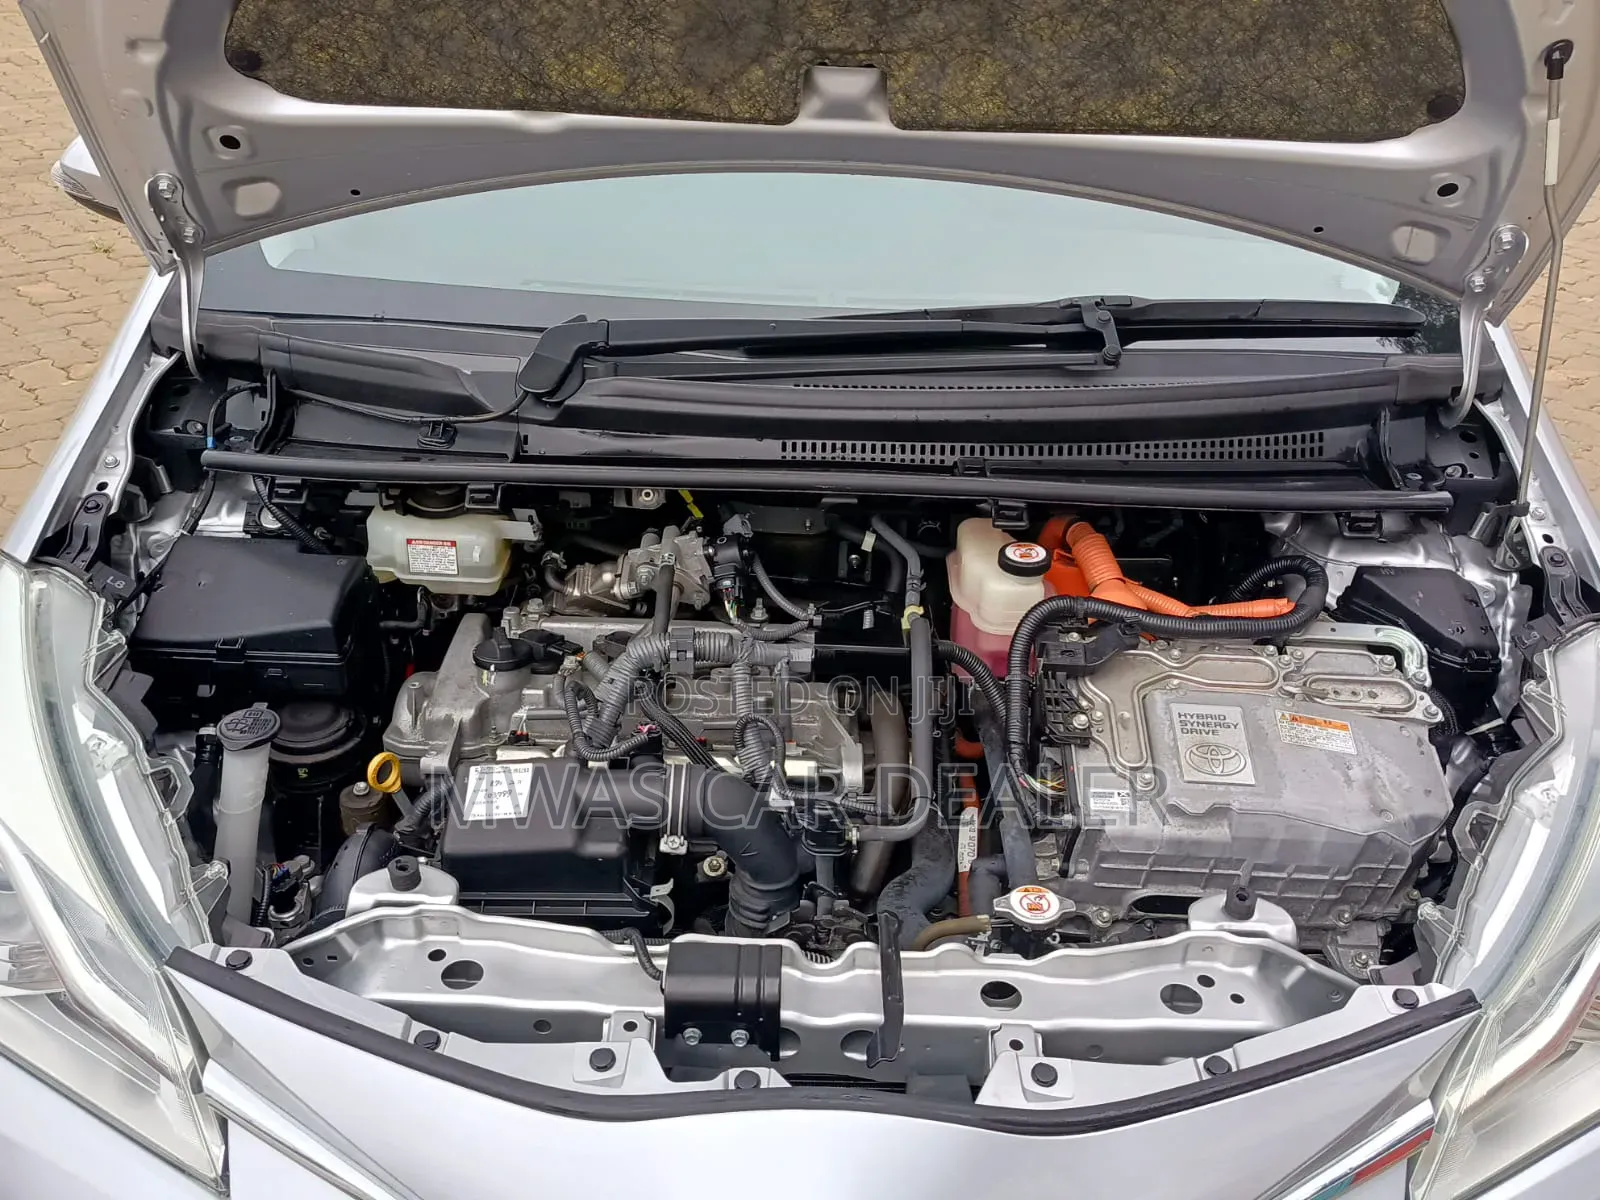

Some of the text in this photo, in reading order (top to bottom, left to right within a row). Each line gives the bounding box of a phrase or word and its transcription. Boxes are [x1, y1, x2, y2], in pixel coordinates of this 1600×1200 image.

[1177, 711, 1227, 721] HYBRID
[1179, 719, 1239, 730] SYNERGY
[1180, 727, 1221, 736] DRIVE
